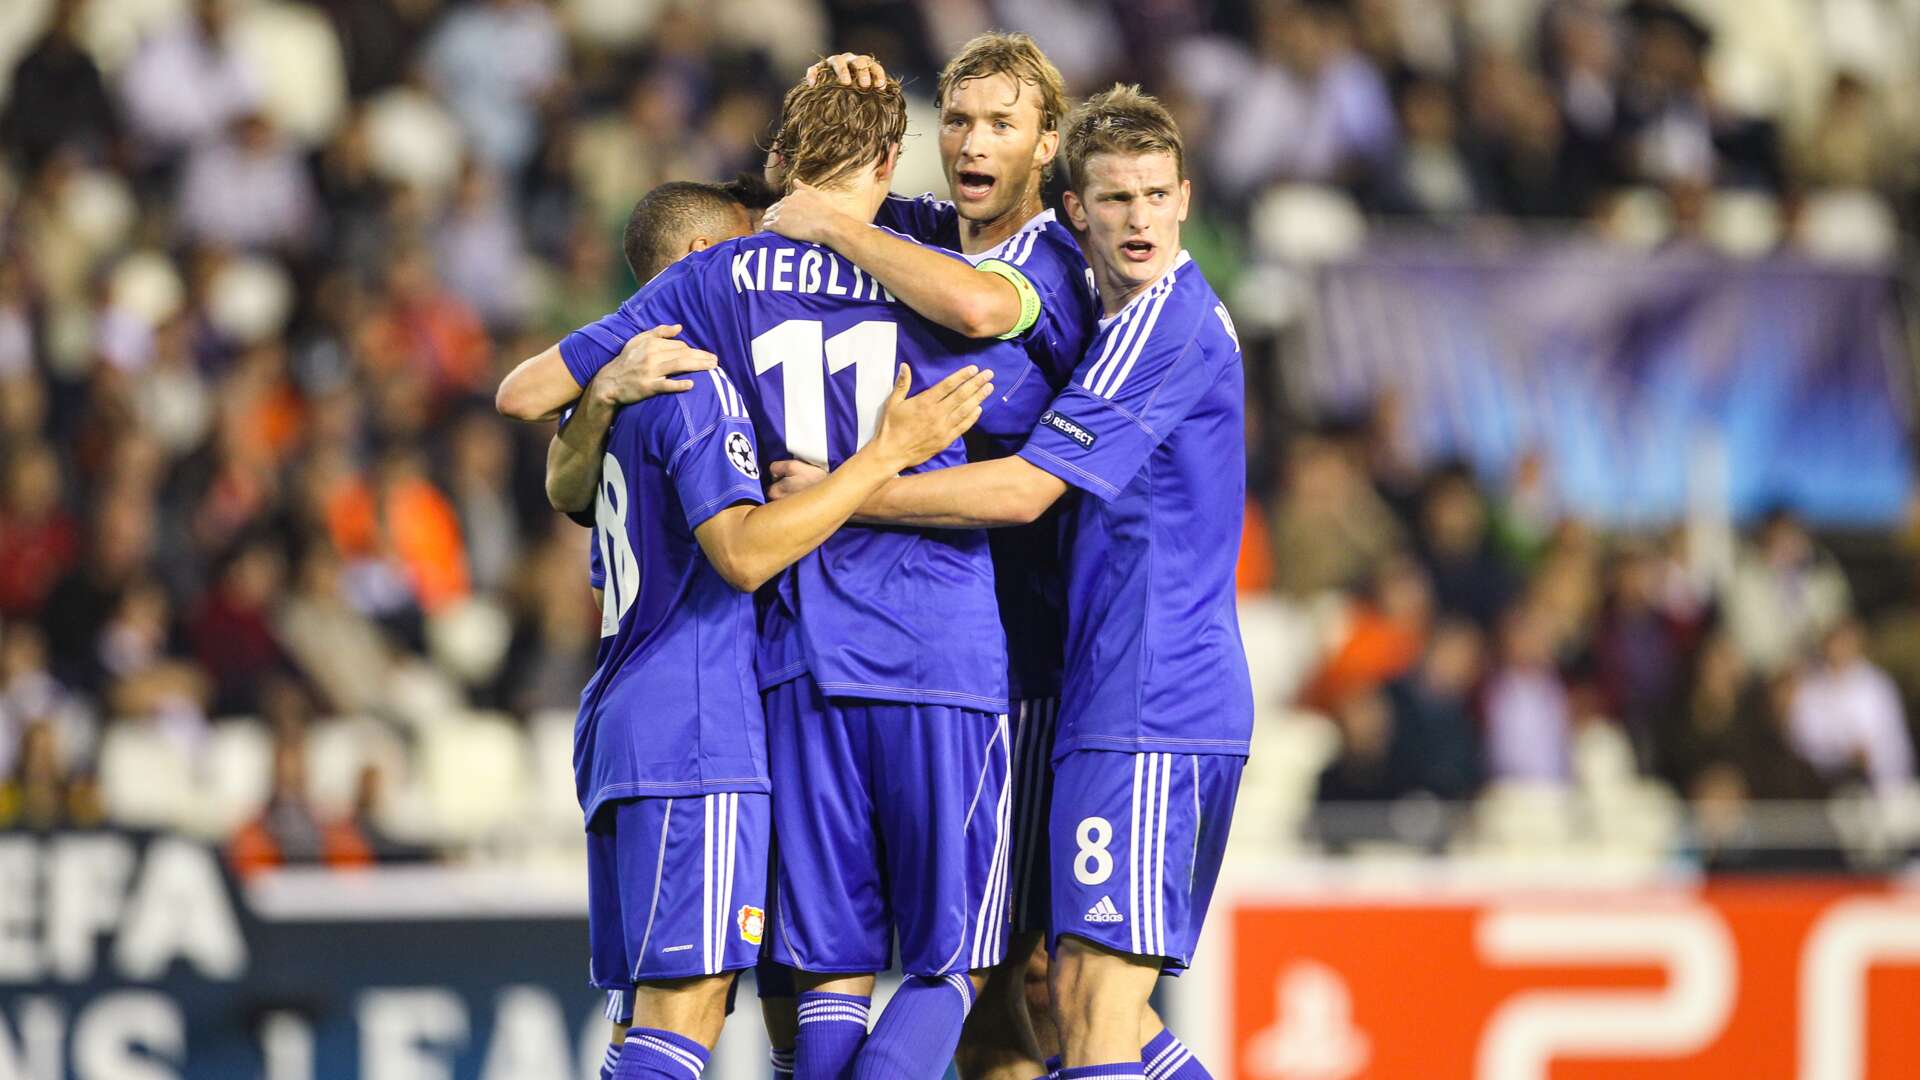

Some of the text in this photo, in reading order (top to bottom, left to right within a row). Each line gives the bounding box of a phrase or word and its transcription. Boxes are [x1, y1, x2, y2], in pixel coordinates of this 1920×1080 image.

[751, 319, 898, 472] 11
[1052, 416, 1094, 446] RESPECT
[1073, 816, 1114, 886] 8
[1084, 912, 1124, 923] adidas
